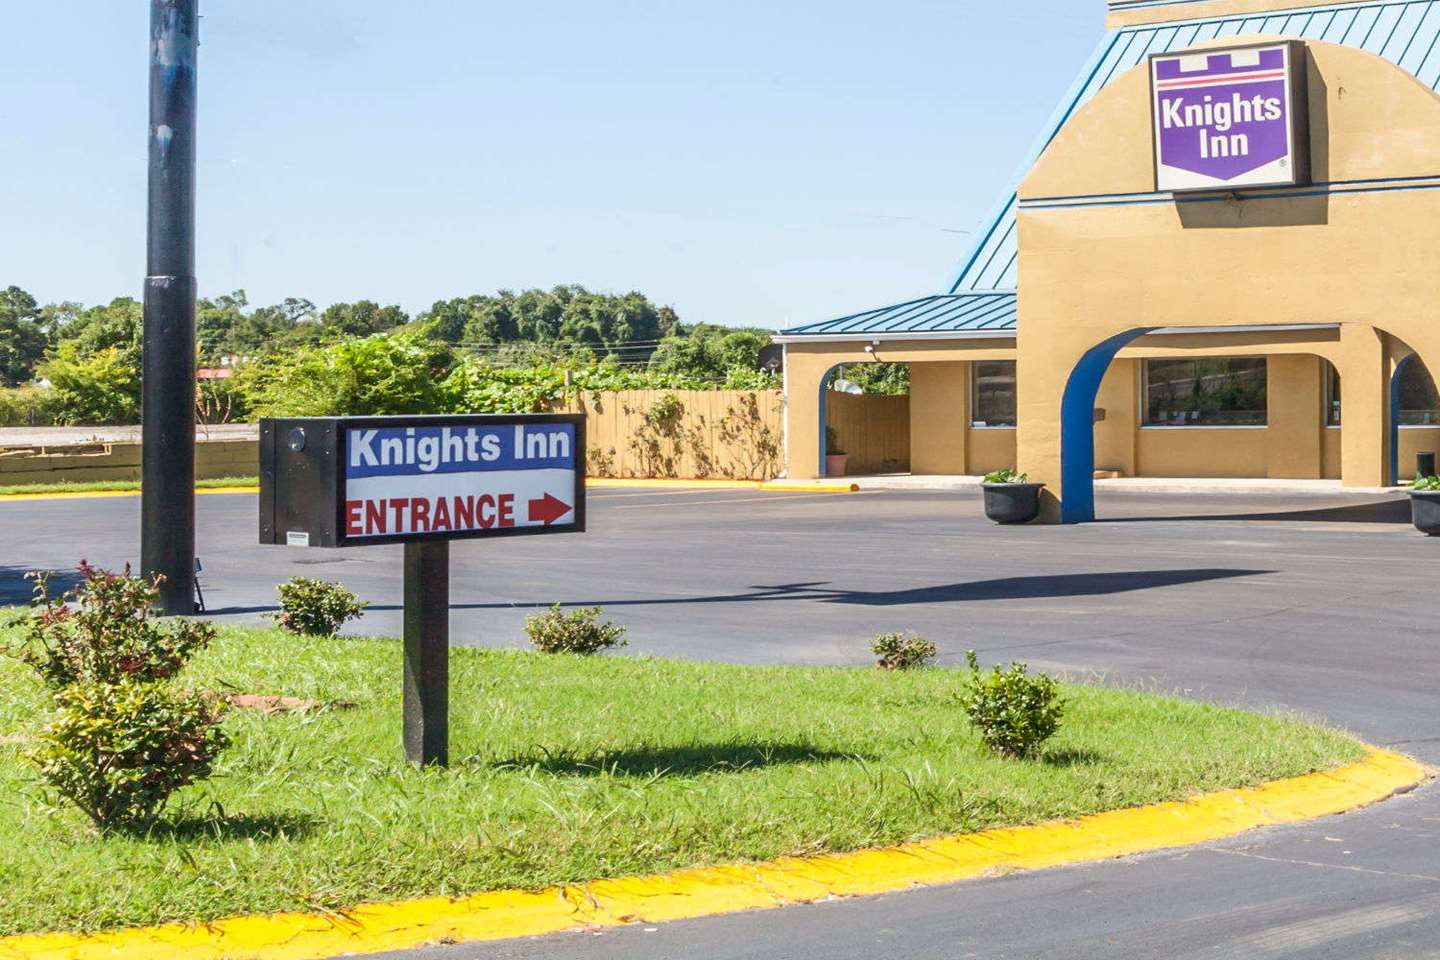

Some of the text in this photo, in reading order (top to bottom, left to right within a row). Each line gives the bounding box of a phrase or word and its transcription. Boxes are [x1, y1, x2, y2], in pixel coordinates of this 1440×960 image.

[1162, 93, 1281, 131] Knights
[1200, 129, 1248, 158] Inn
[351, 424, 570, 471] Knights Inn
[346, 494, 515, 535] ENTRANCE
